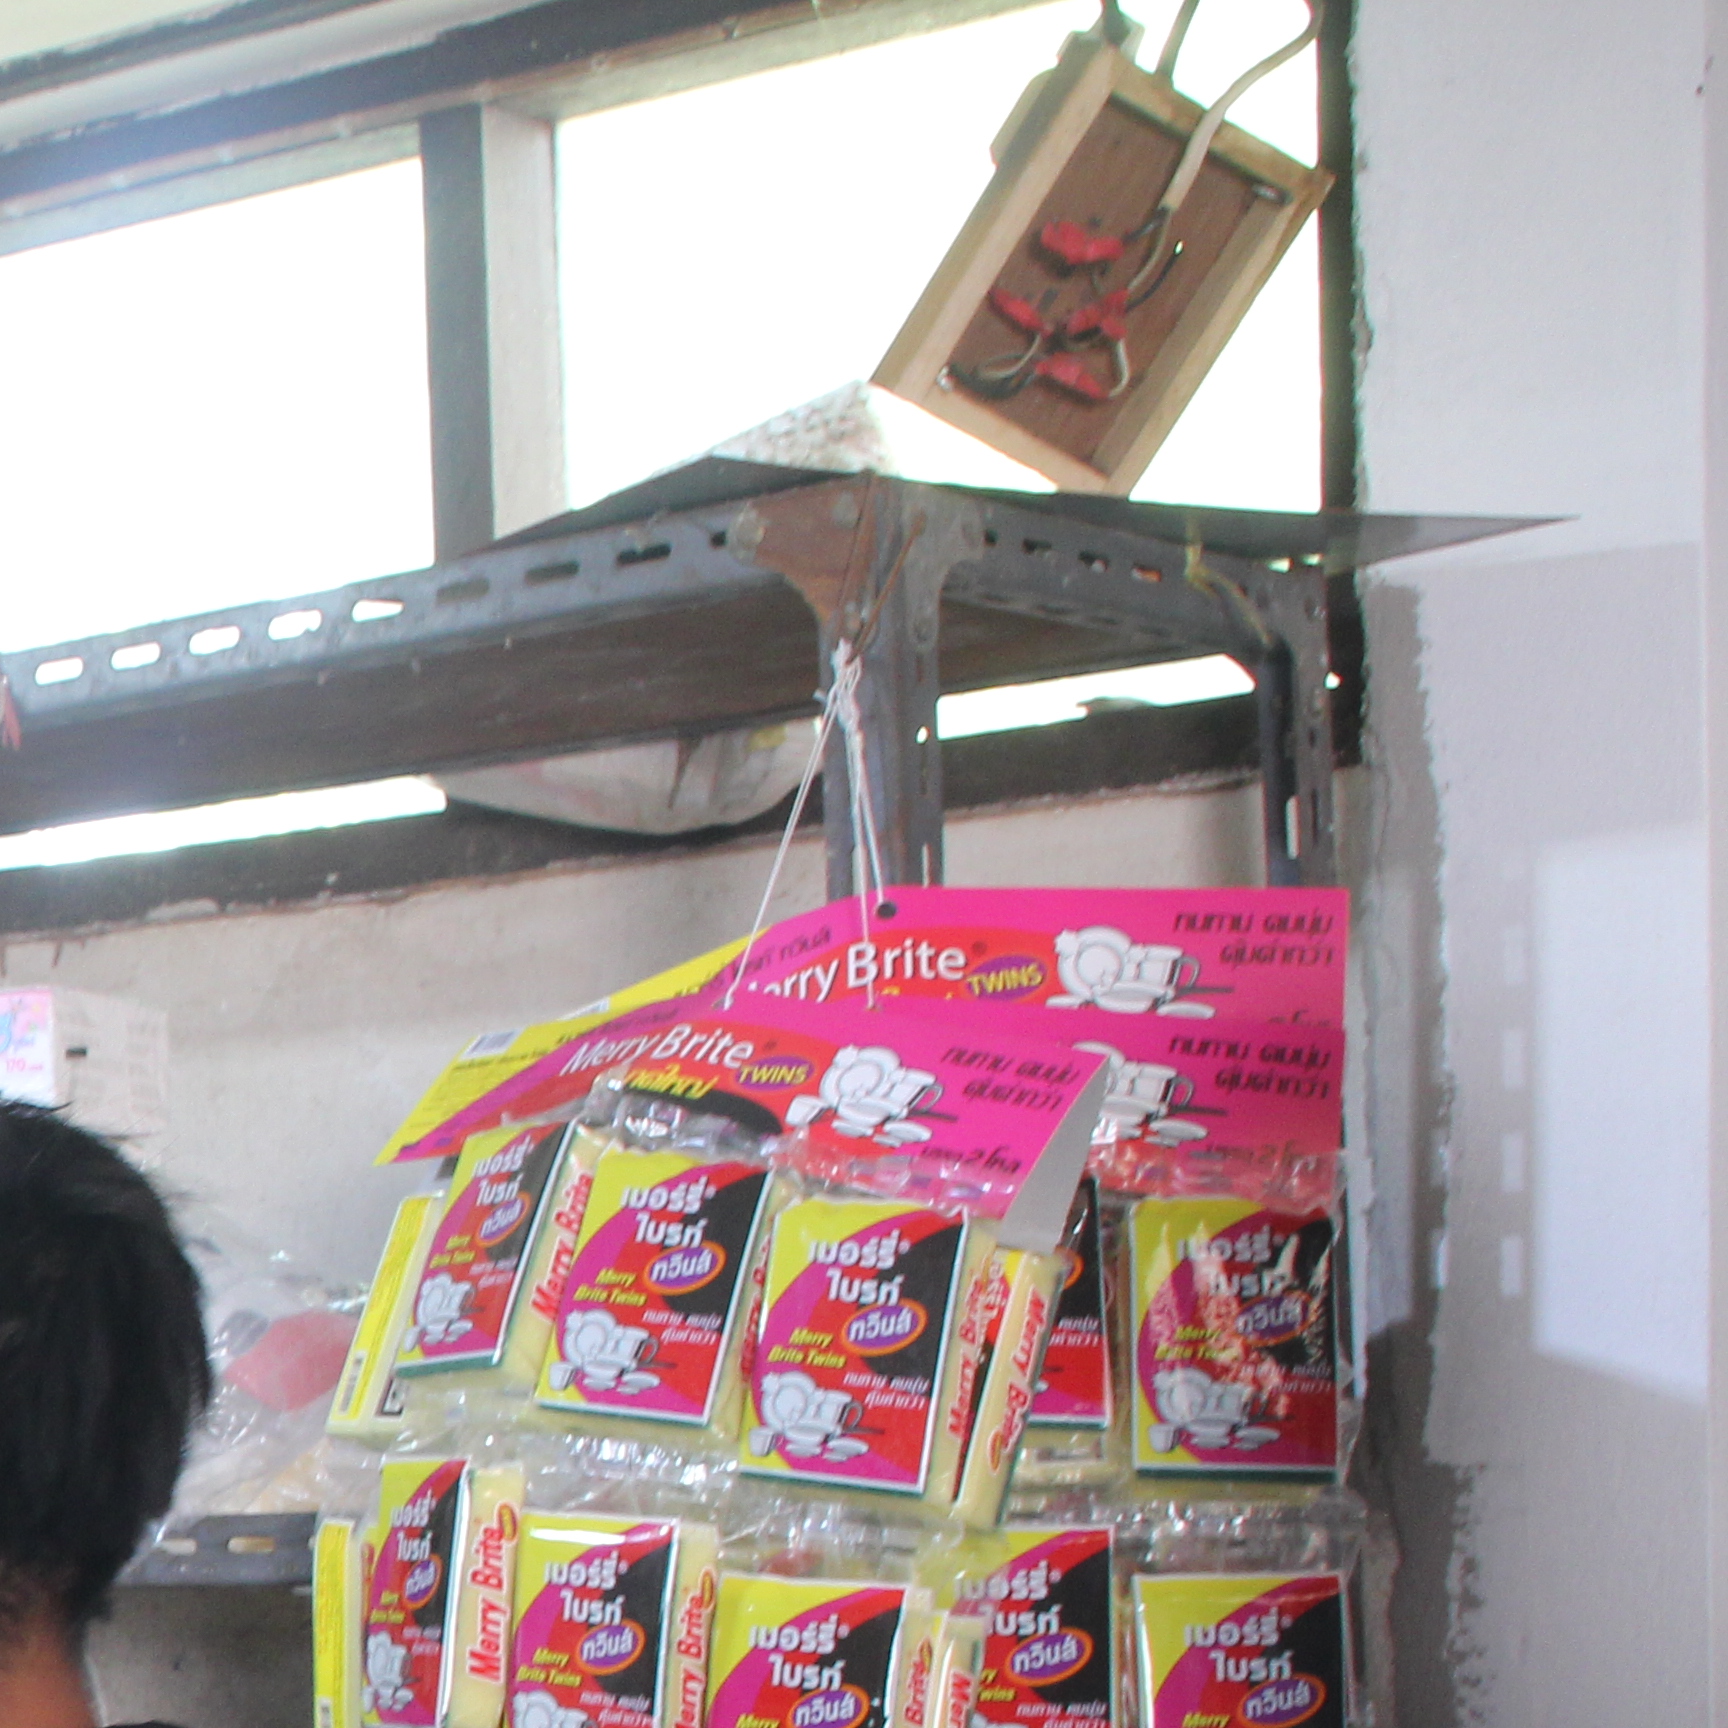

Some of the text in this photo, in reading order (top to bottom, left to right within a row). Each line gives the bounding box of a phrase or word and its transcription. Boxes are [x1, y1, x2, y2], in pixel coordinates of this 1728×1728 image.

[846, 938, 968, 988] Brite
[966, 964, 1044, 998] TWINS
[558, 1033, 660, 1077] Merry
[650, 1022, 755, 1069] Brite
[737, 1063, 811, 1085] TWINS
[620, 1177, 708, 1215] เมอร์รี่
[634, 1213, 705, 1248] ไบรท์
[808, 1229, 900, 1269] เมอร์รี่
[826, 1267, 905, 1307] ไบรท์
[544, 1550, 619, 1590] เมอร์รี่
[468, 1526, 510, 1681] Merry Brite
[561, 1590, 623, 1624] ไบรท์
[749, 1614, 839, 1653] เมอร์รี่
[1184, 1607, 1281, 1648] เมอร์รี่
[768, 1653, 846, 1691] ไบรท์
[1012, 1636, 1079, 1673] ทวินส์
[1210, 1649, 1295, 1683] ไบรท์
